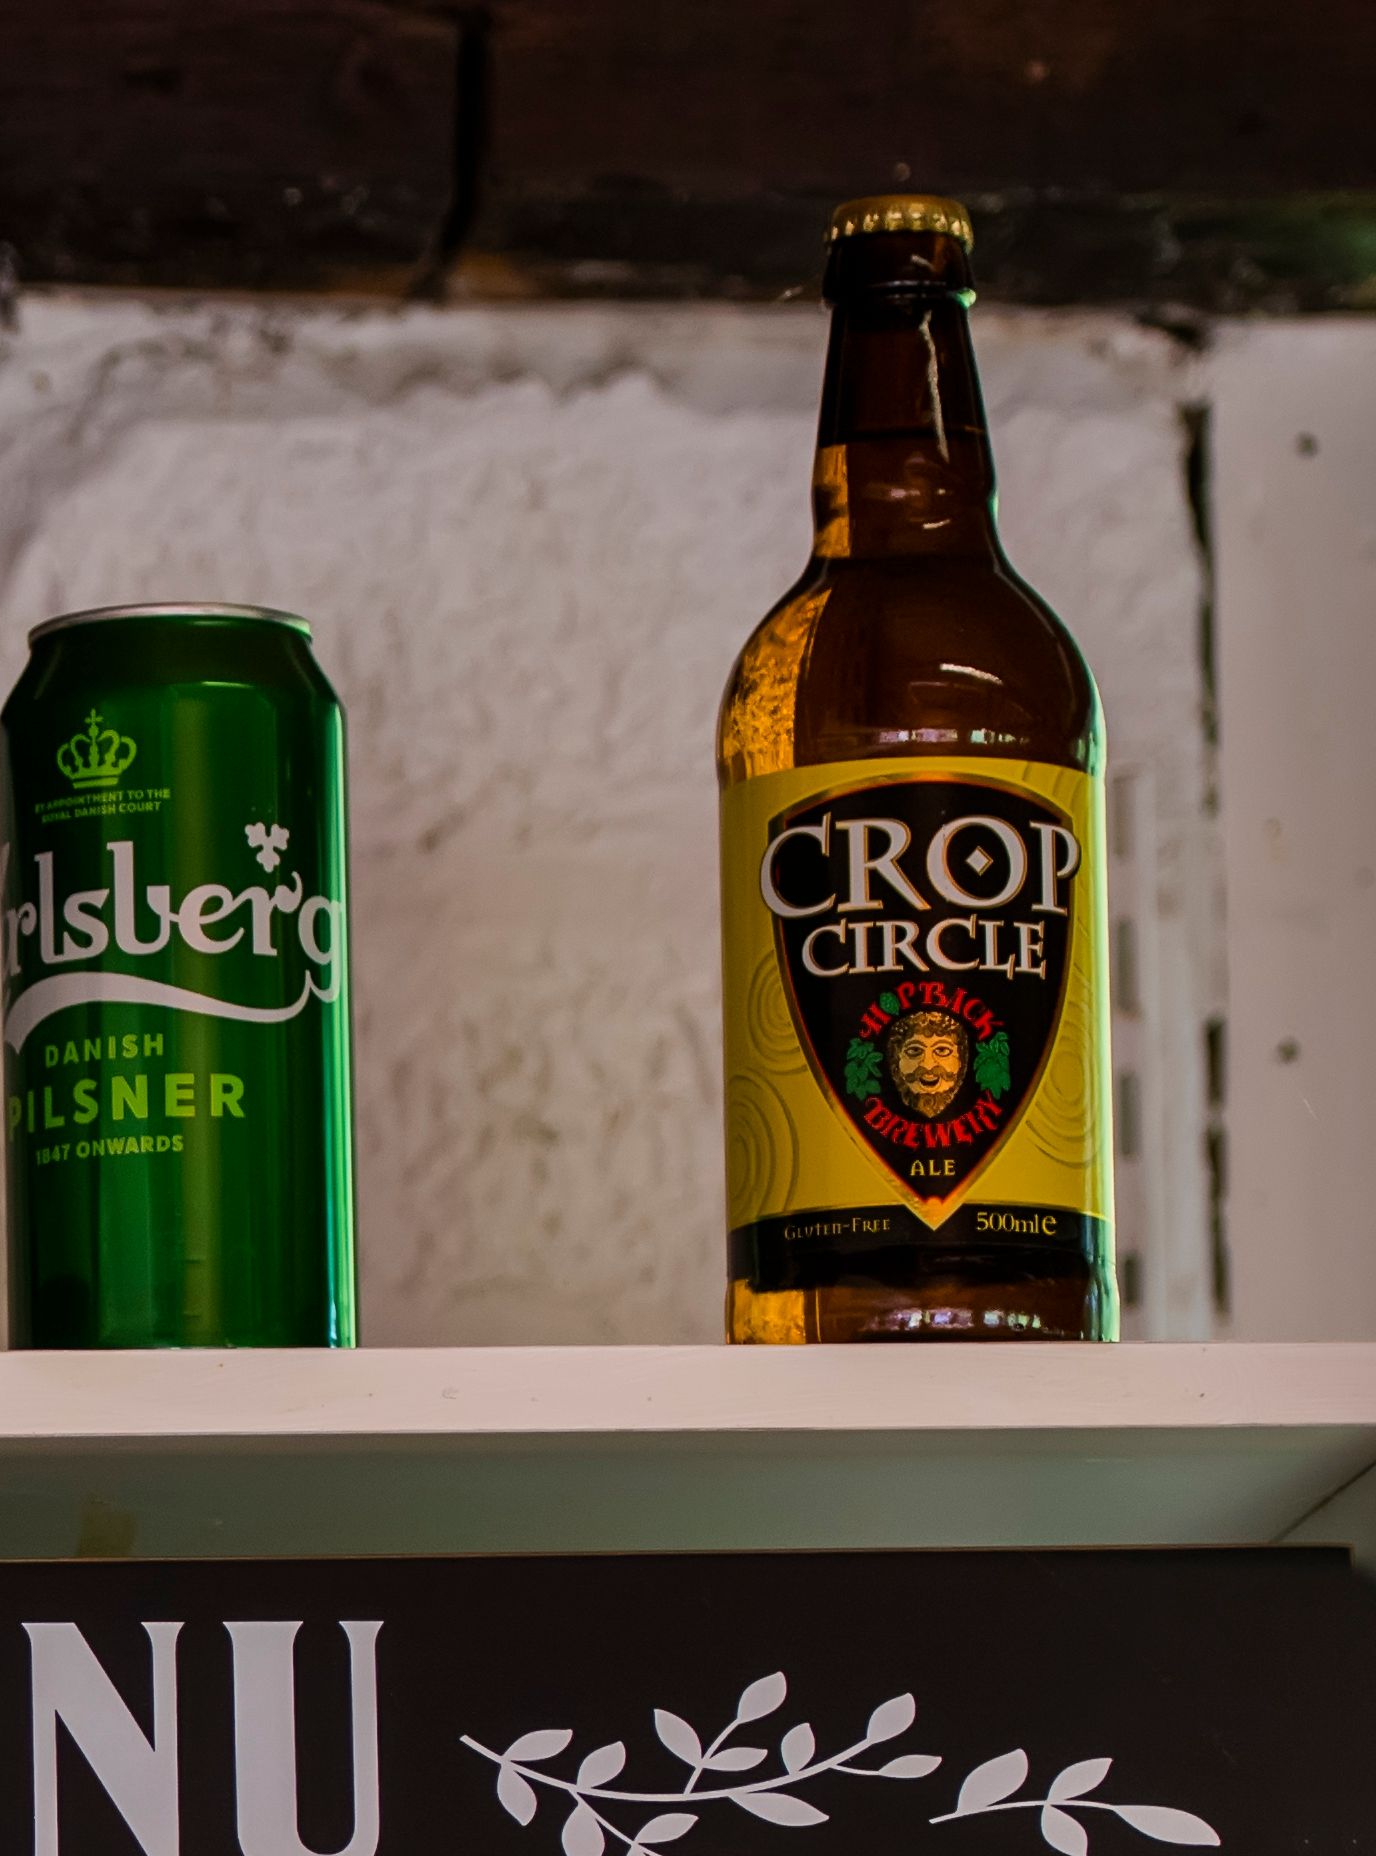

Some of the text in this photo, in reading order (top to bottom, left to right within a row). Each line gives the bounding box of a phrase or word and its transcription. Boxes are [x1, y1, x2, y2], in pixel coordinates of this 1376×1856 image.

[74, 803, 116, 818] DANISH
[119, 801, 161, 813] COURT
[127, 789, 144, 800] TO
[147, 788, 171, 799] THE
[759, 811, 1082, 919] CROP
[0, 841, 342, 1002] rlsberg
[801, 913, 1047, 981] CIRCLE
[45, 1033, 164, 1068] DANISH
[8, 1072, 246, 1141] PILSNER
[863, 1090, 1003, 1148] BREWERY
[36, 1134, 184, 1166] 1847 ONWARDS
[909, 1159, 956, 1177] ALE
